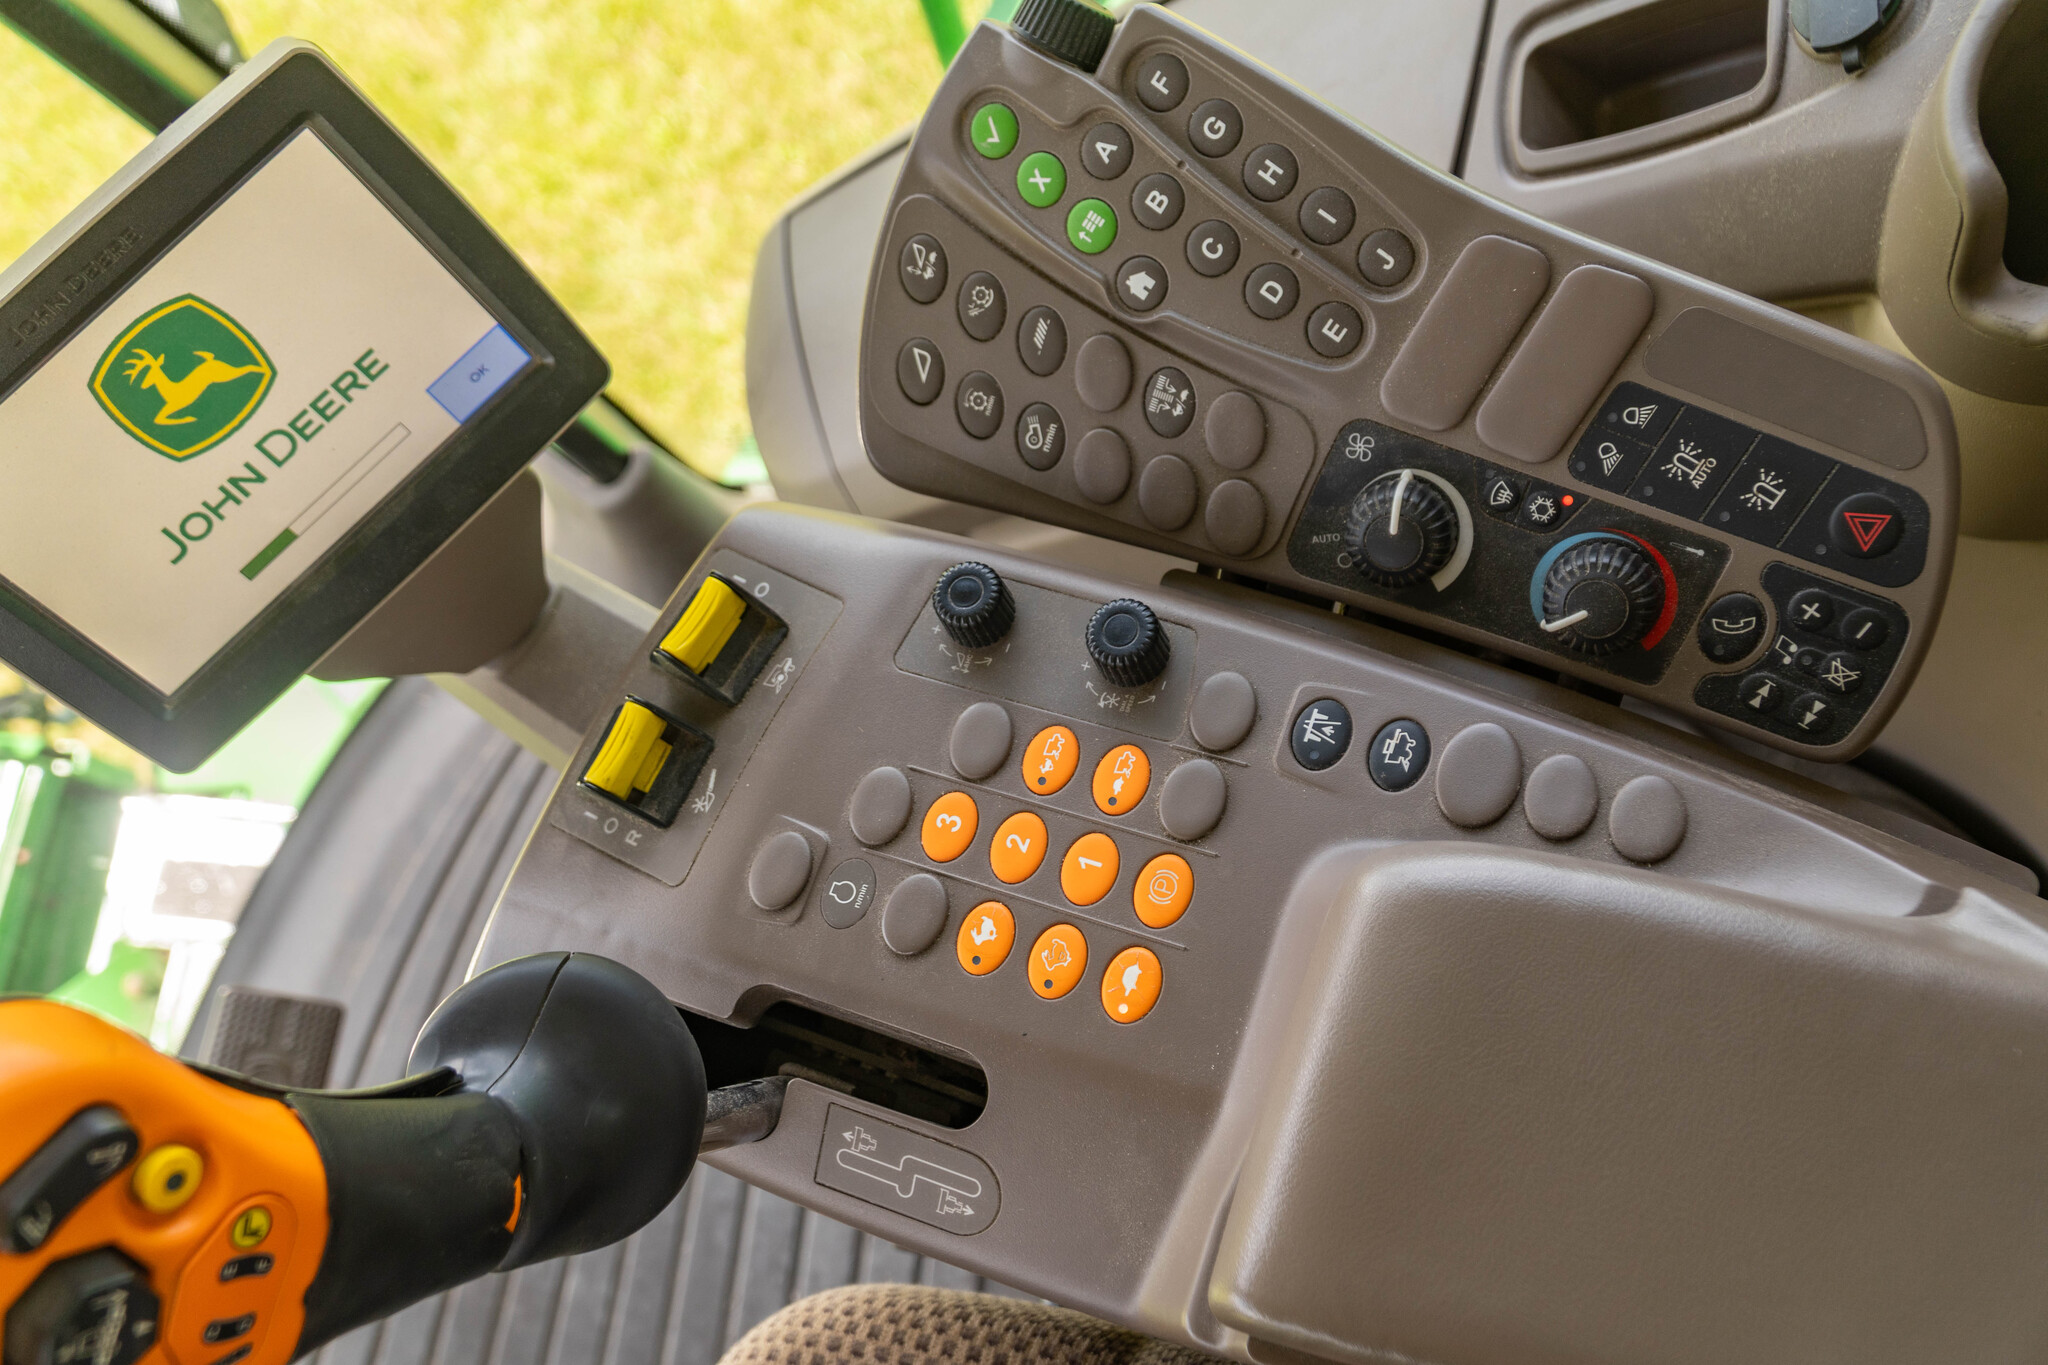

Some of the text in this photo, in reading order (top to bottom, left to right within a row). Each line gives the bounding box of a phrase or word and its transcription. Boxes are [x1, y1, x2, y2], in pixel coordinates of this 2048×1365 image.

[1150, 70, 1170, 95] F
[1203, 116, 1227, 140] G
[1094, 140, 1119, 164] A
[1257, 158, 1284, 186] H
[1145, 189, 1169, 215] B
[1317, 208, 1337, 225] I
[1201, 237, 1224, 260] C
[1376, 247, 1396, 271] J
[1260, 280, 1284, 304] D
[1321, 318, 1348, 343] E
[469, 363, 491, 384] OK
[1043, 422, 1058, 453] n/min
[161, 348, 390, 565] JOHN DEERE
[1690, 457, 1717, 489] AUTO
[1311, 532, 1342, 545] AUTO
[936, 812, 962, 833] 3
[625, 828, 643, 847] R
[1006, 833, 1031, 854] 2
[1078, 855, 1103, 870] 1
[853, 882, 869, 909] n/min
[1154, 877, 1172, 895] P
